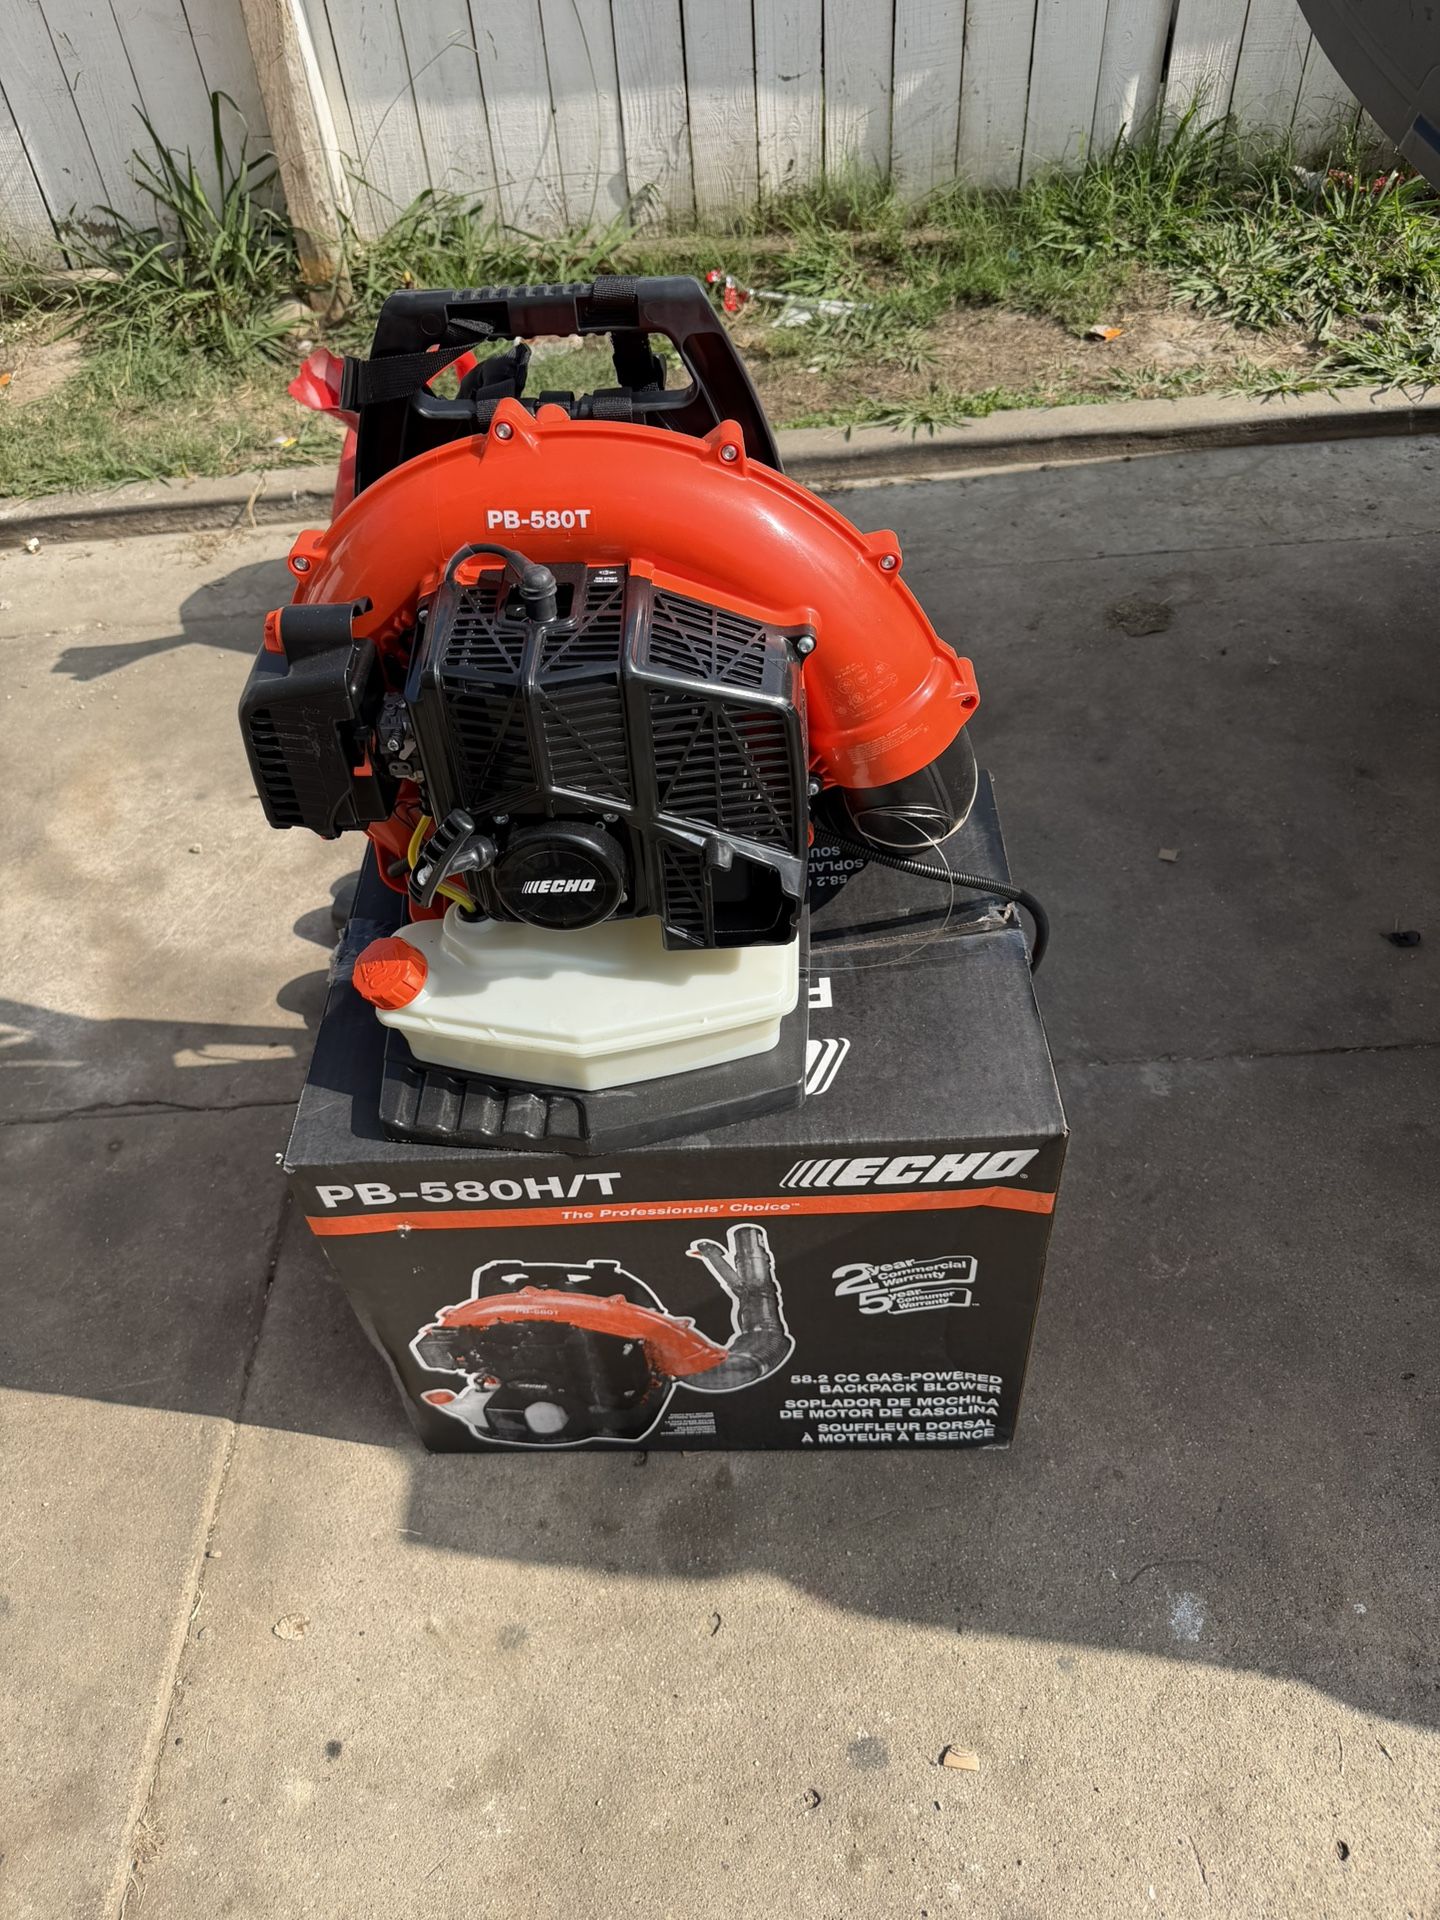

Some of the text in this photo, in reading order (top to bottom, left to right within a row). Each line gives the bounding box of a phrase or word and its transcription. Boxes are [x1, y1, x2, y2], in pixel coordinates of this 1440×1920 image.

[487, 509, 591, 529] PB-580T
[537, 879, 596, 894] ECHO
[816, 874, 848, 887] 58.2
[833, 1149, 1040, 1186] ECHO
[315, 1172, 622, 1208] PB-580H/T
[561, 1211, 594, 1220] The
[832, 1258, 916, 1297] 2 year
[878, 1261, 966, 1281] Commercial
[882, 1271, 946, 1287] Warranty
[858, 1288, 923, 1315] 5 year
[896, 1291, 955, 1304] Consumer
[898, 1298, 949, 1310] Warranty
[790, 1371, 1003, 1385] 58.2 CC GAS-POWERED
[819, 1381, 1001, 1394] BACKPACK BLOWER
[784, 1395, 999, 1408] SOPLADOR DE MOCHILA
[779, 1405, 998, 1419] DE MOTOR DE GASOLINA
[817, 1418, 996, 1432] SOUFFLEUR DORSAL
[801, 1427, 995, 1443] À MOTEUR À ESSENCE
